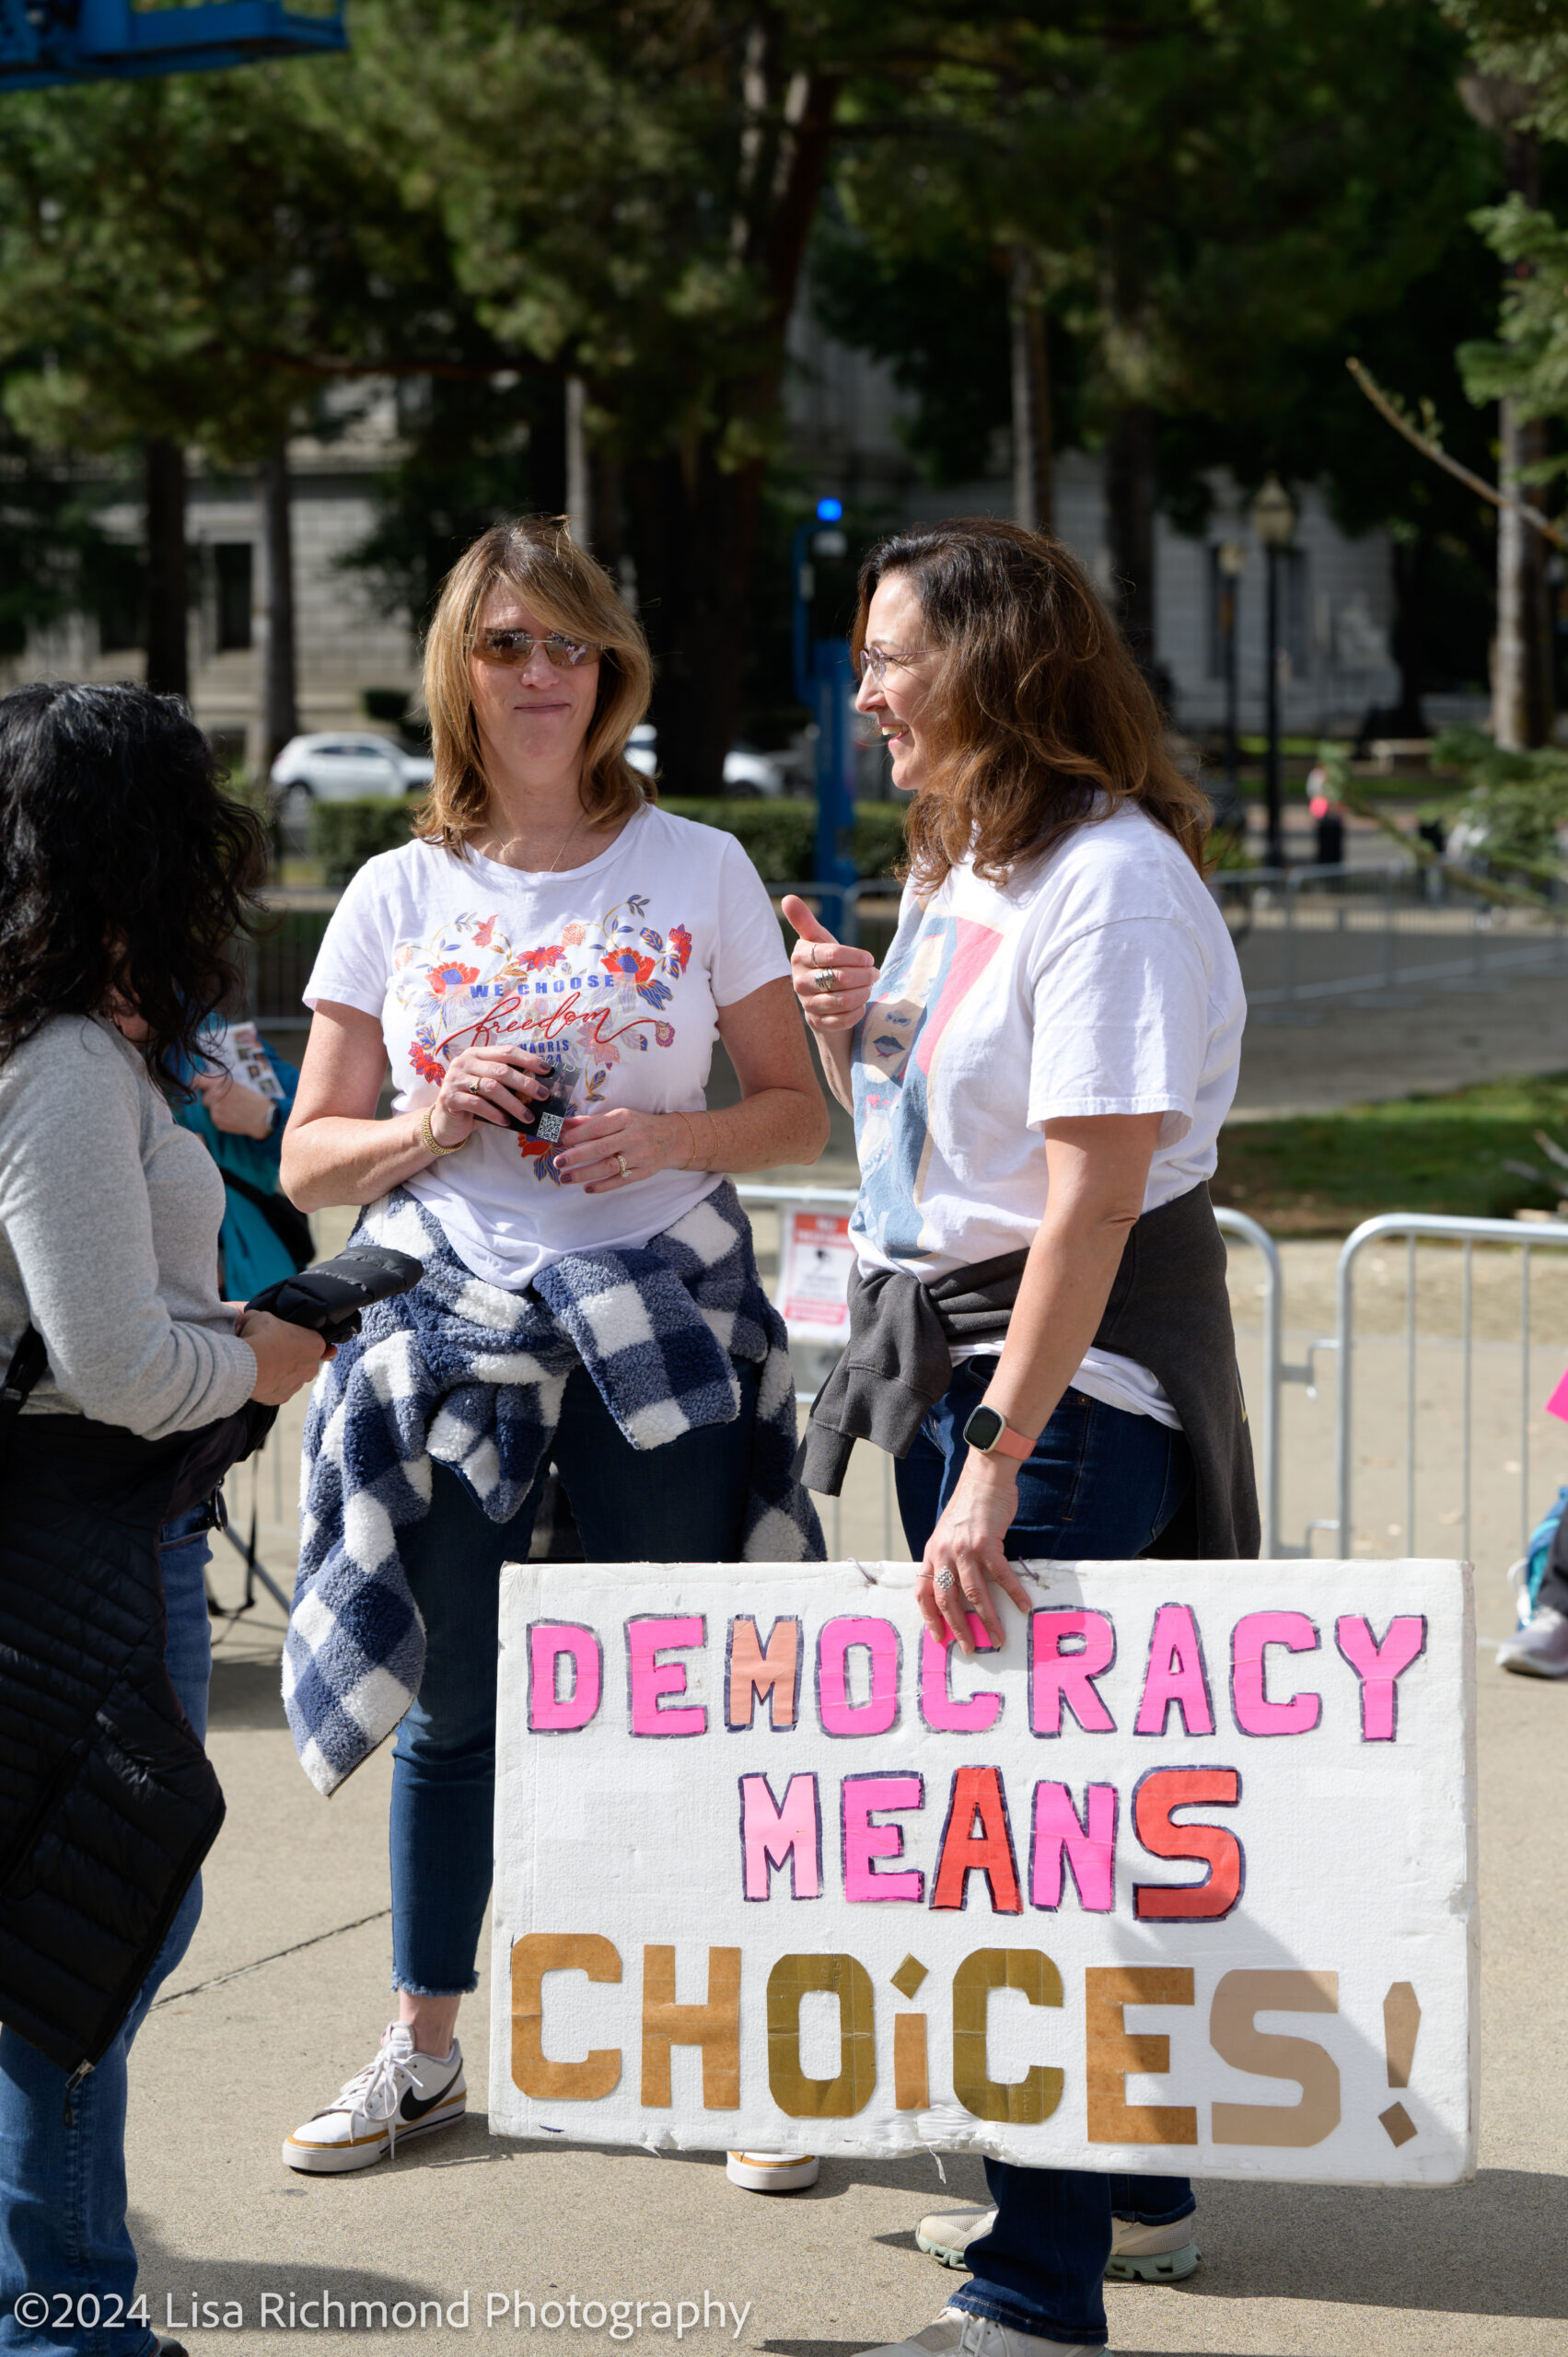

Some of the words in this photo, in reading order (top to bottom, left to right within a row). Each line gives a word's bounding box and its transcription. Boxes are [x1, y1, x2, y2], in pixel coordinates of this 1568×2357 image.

[435, 991, 657, 1056] freedom
[470, 984, 505, 999] WE
[517, 974, 615, 995] CHOOSE
[526, 1601, 1427, 1743] DEMOCRACY
[738, 1764, 1246, 1923] MEANS
